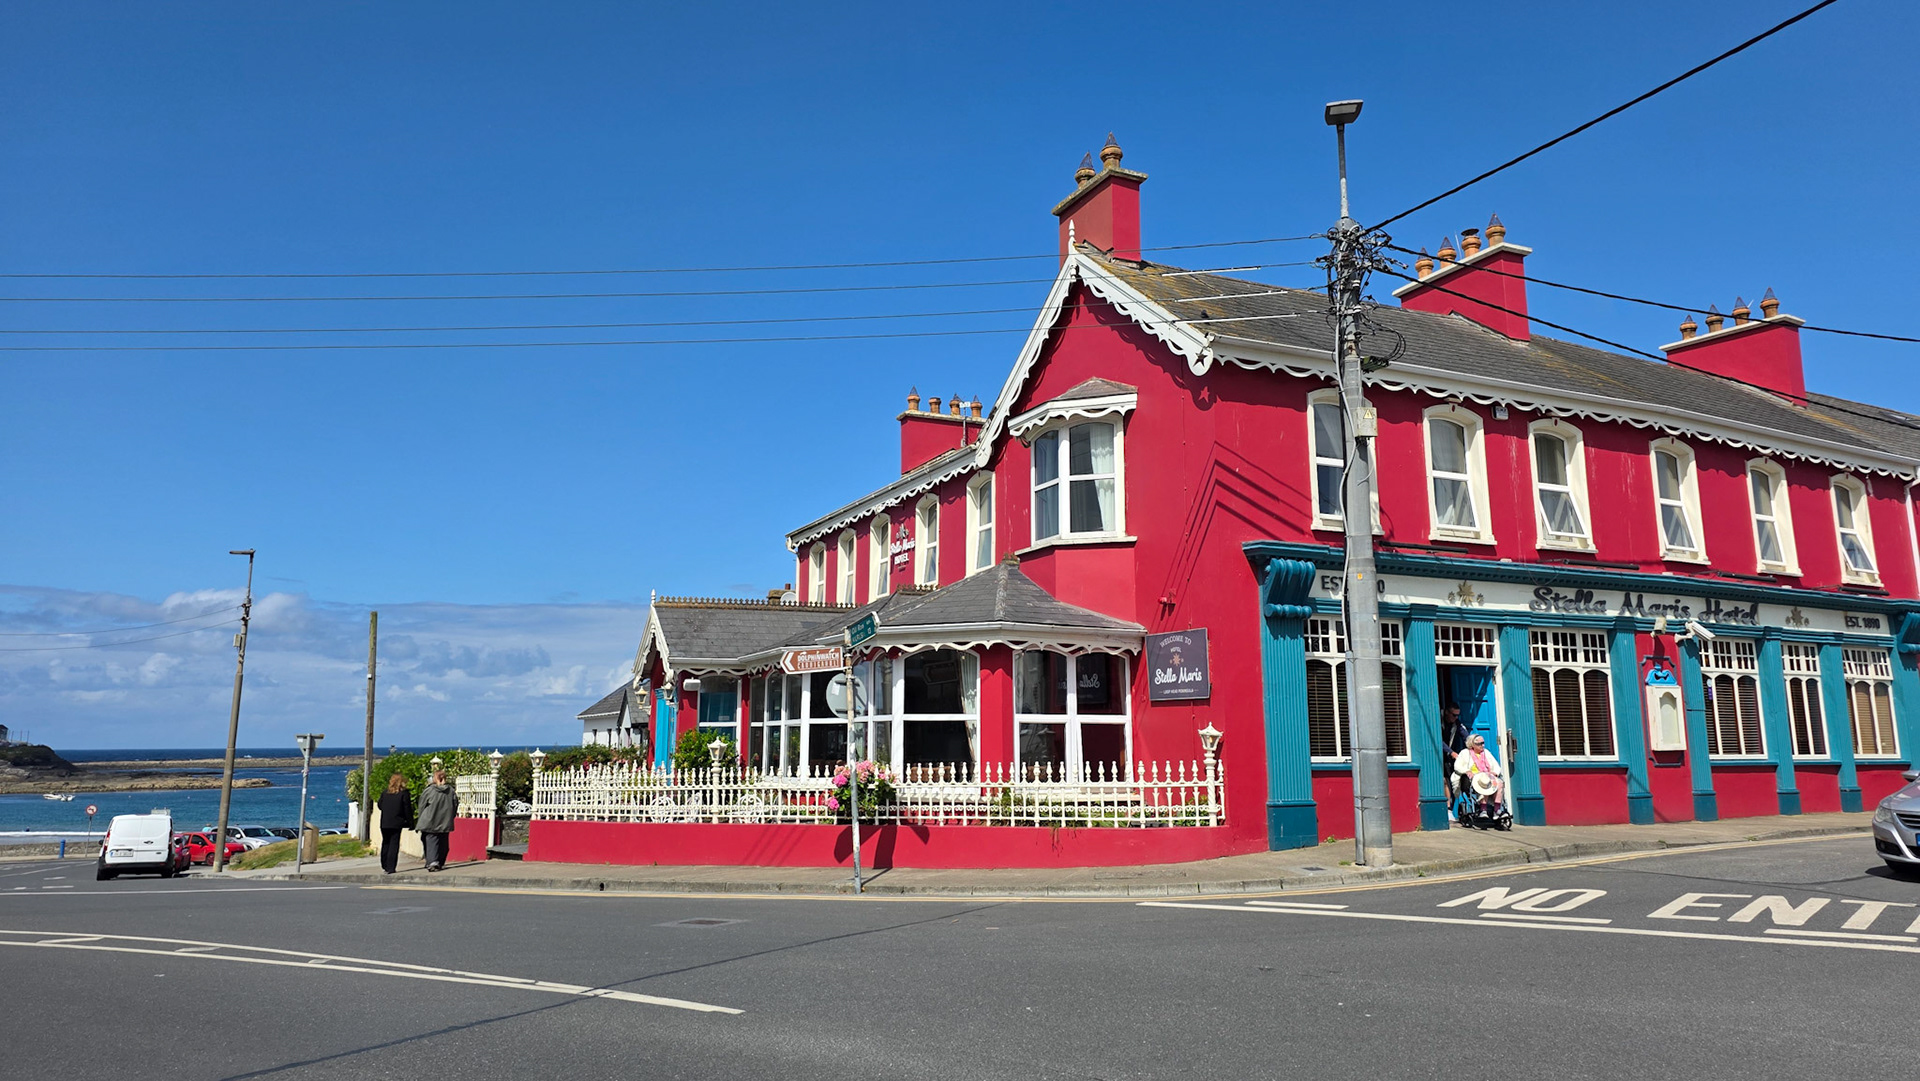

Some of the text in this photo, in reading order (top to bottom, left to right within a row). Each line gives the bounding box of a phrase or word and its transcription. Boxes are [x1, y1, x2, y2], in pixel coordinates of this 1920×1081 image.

[1529, 586, 1760, 626] Stella Maris Hotel
[1160, 635, 1192, 647] WELCOME TO
[798, 653, 839, 662] DOLPHINWATCH
[1155, 667, 1202, 684] Stella Maris
[1436, 887, 1920, 933] NO ENT
